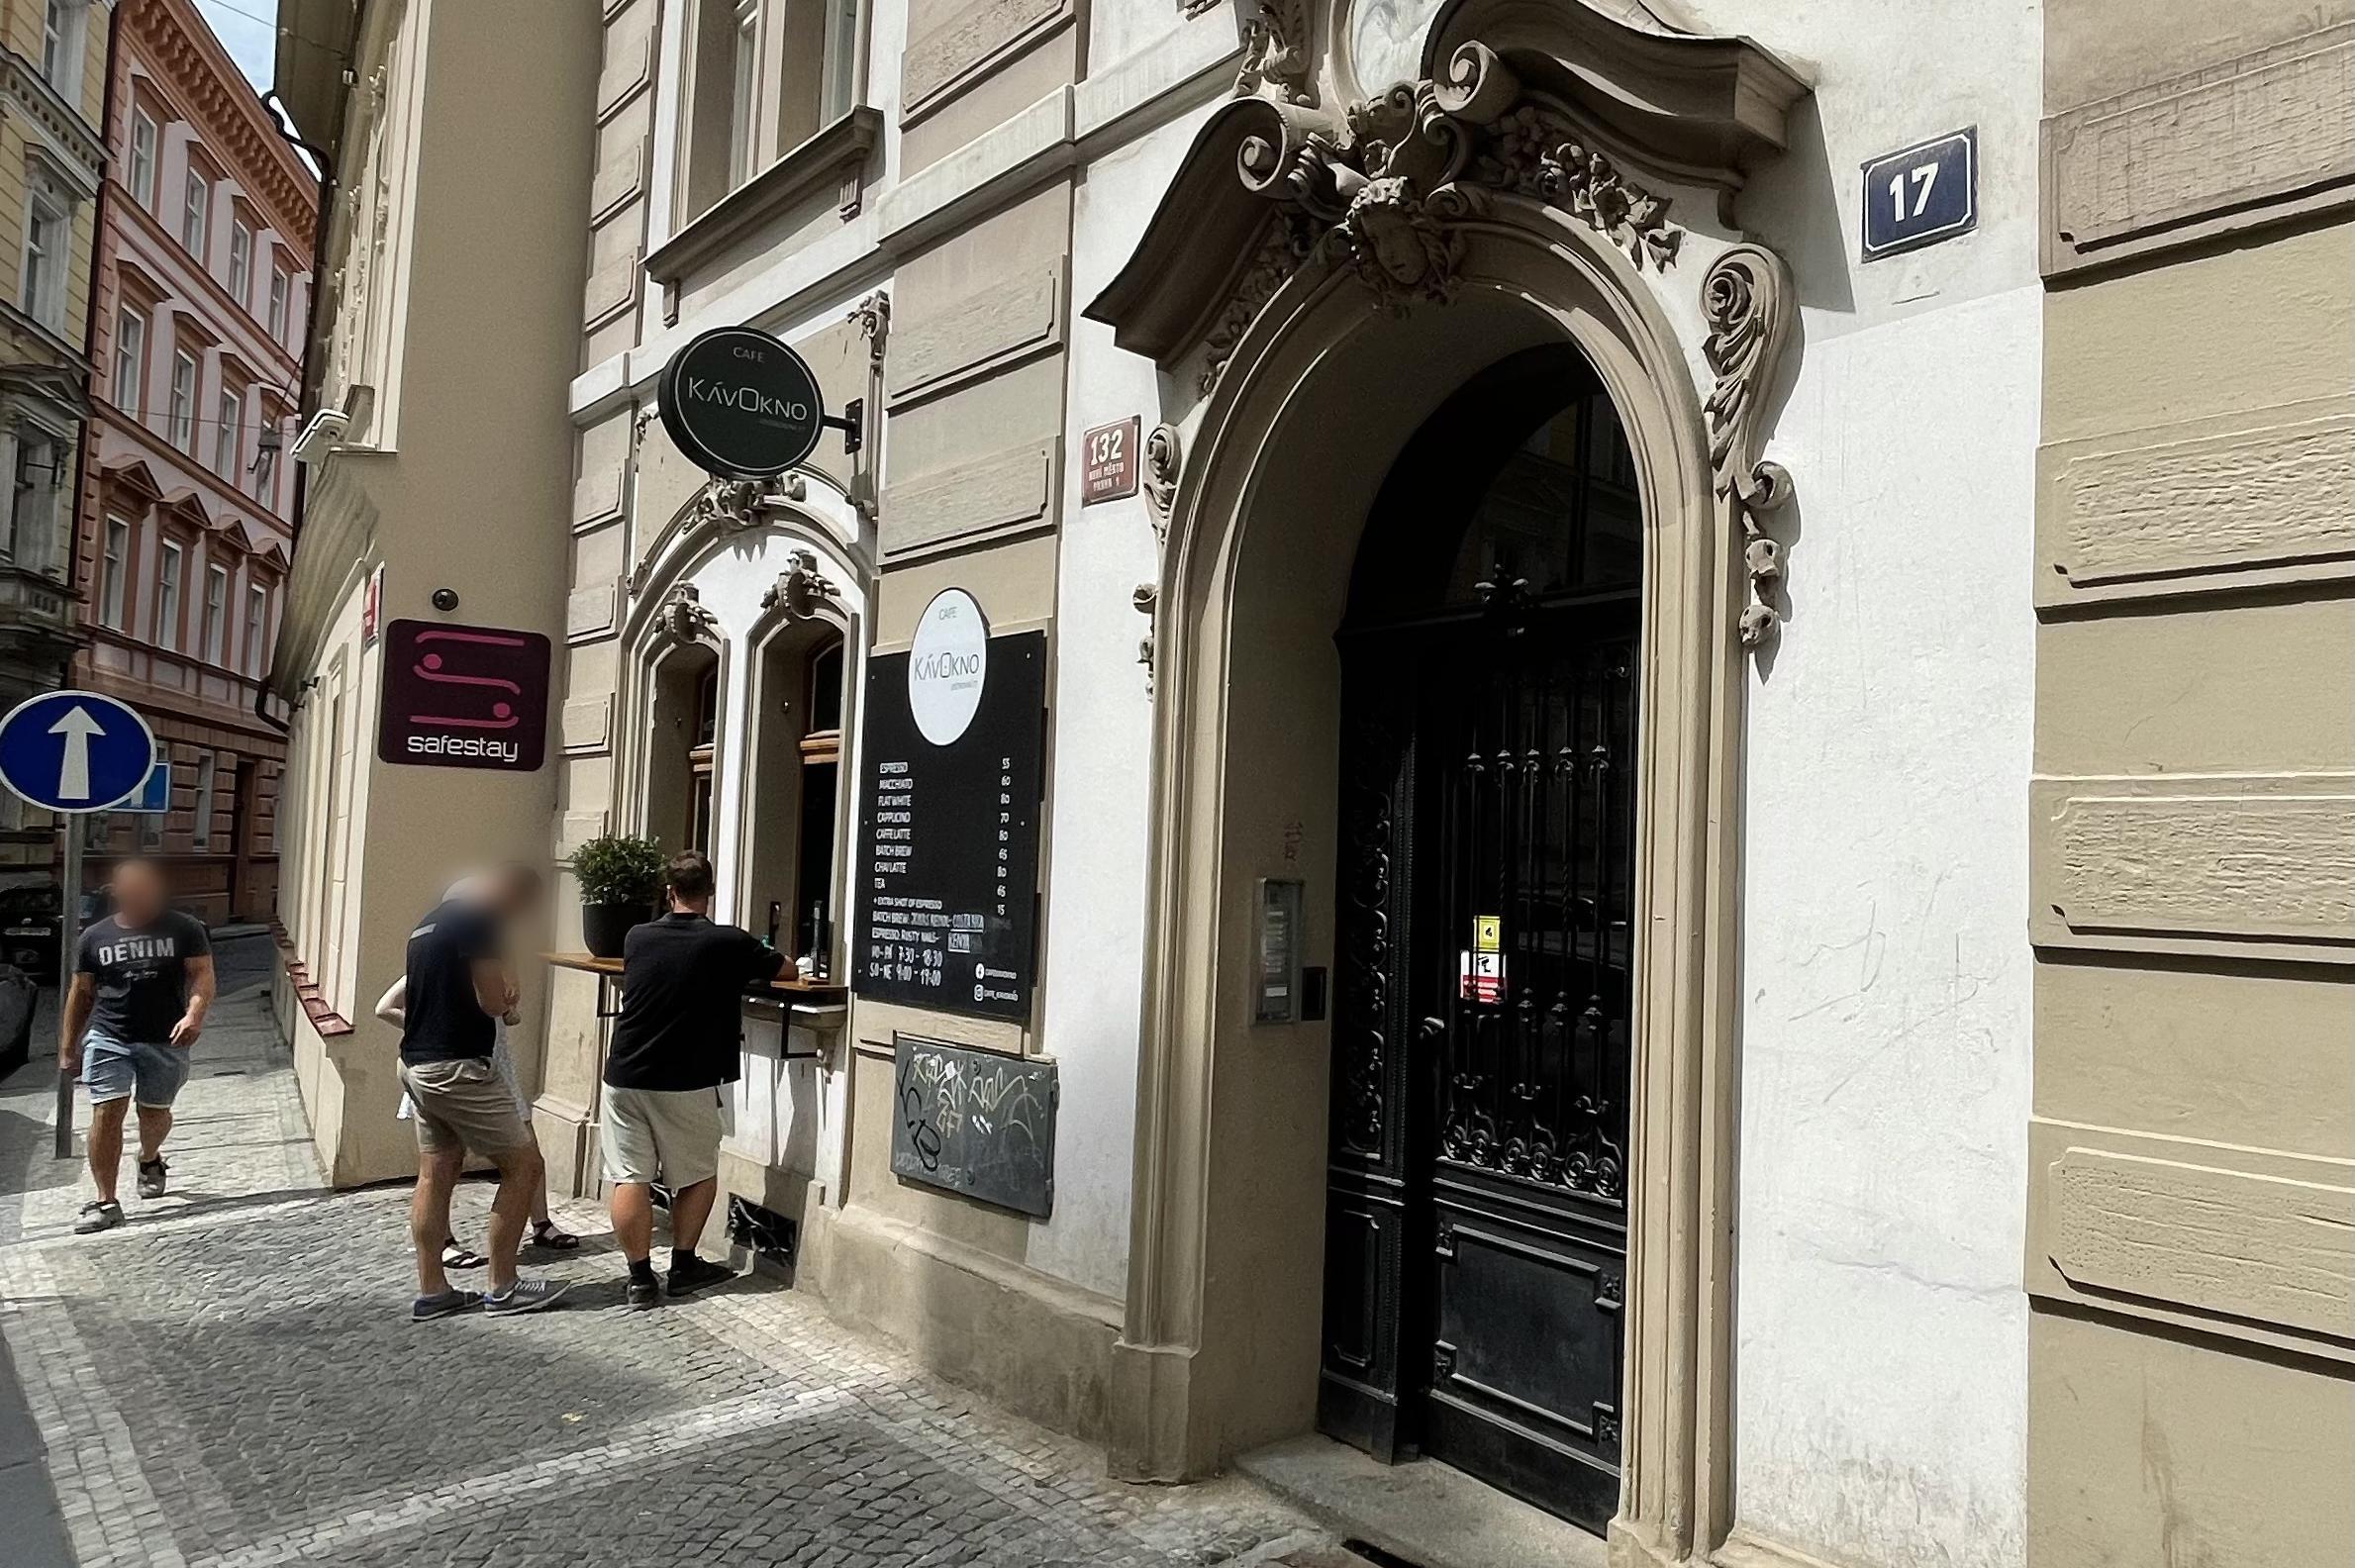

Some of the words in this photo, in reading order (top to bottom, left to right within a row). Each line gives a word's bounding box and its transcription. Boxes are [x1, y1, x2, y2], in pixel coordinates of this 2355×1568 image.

[1889, 161, 1939, 223] 17
[733, 346, 765, 363] CAFE
[688, 376, 808, 421] KÁVOKNO
[1090, 429, 1124, 466] 132
[938, 606, 958, 621] CAFE
[914, 652, 980, 681] KÁVOKNO
[407, 735, 519, 762] safestay
[1002, 757, 1011, 770] 55
[1001, 775, 1011, 786] 60
[1000, 793, 1010, 805] 80
[1000, 812, 1010, 824] 70
[998, 830, 1009, 841] 80
[998, 847, 1008, 860] 65
[997, 865, 1007, 878] 80
[874, 877, 886, 889] TEA
[997, 884, 1007, 898] 65
[98, 937, 175, 966] DENIM
